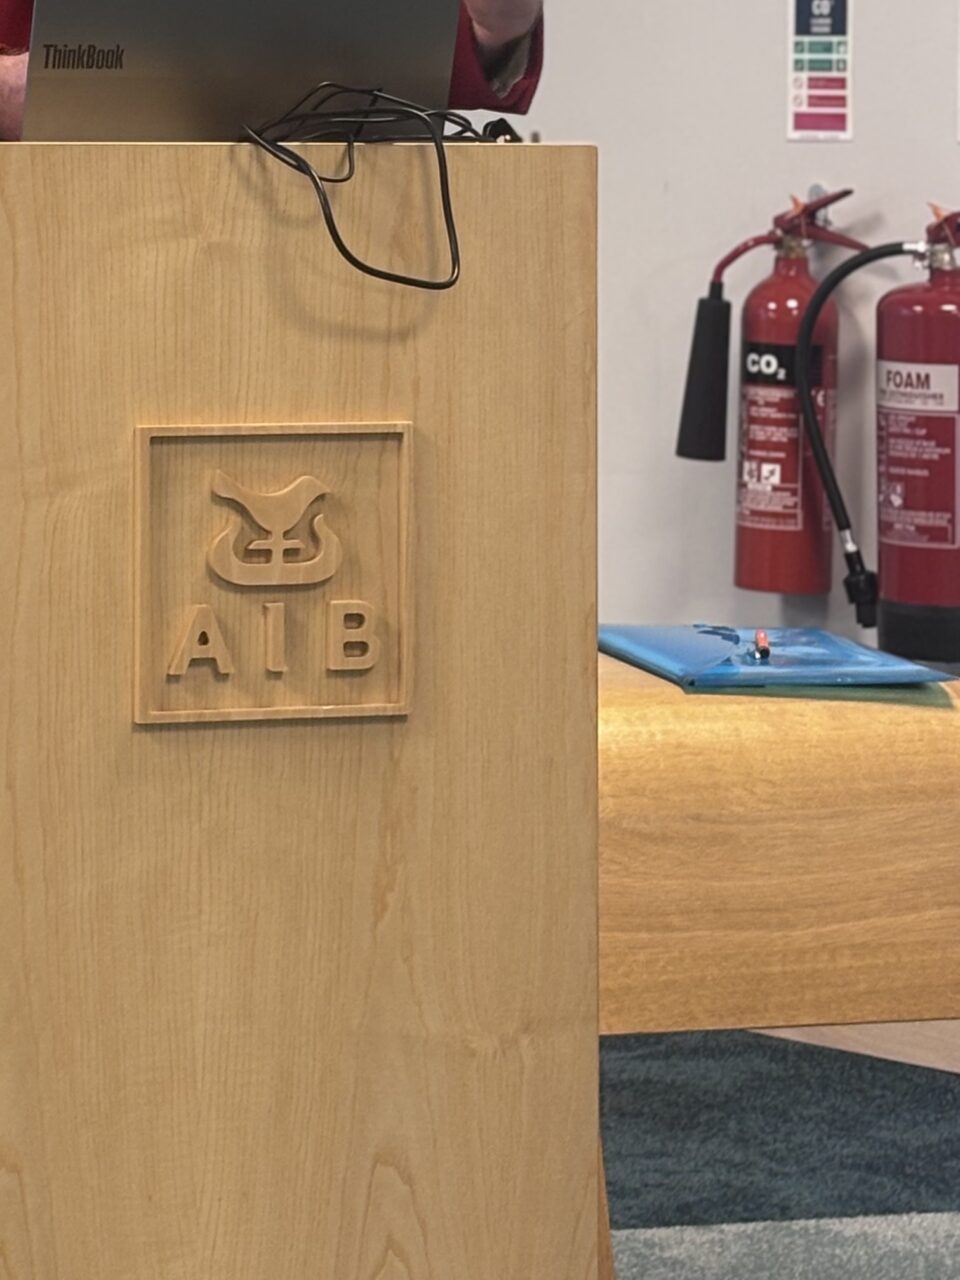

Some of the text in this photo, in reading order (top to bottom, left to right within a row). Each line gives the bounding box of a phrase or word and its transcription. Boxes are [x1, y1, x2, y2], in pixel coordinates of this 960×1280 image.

[43, 44, 125, 70] ThinkBook
[886, 369, 931, 390] FOAM
[166, 599, 380, 677] AIB
